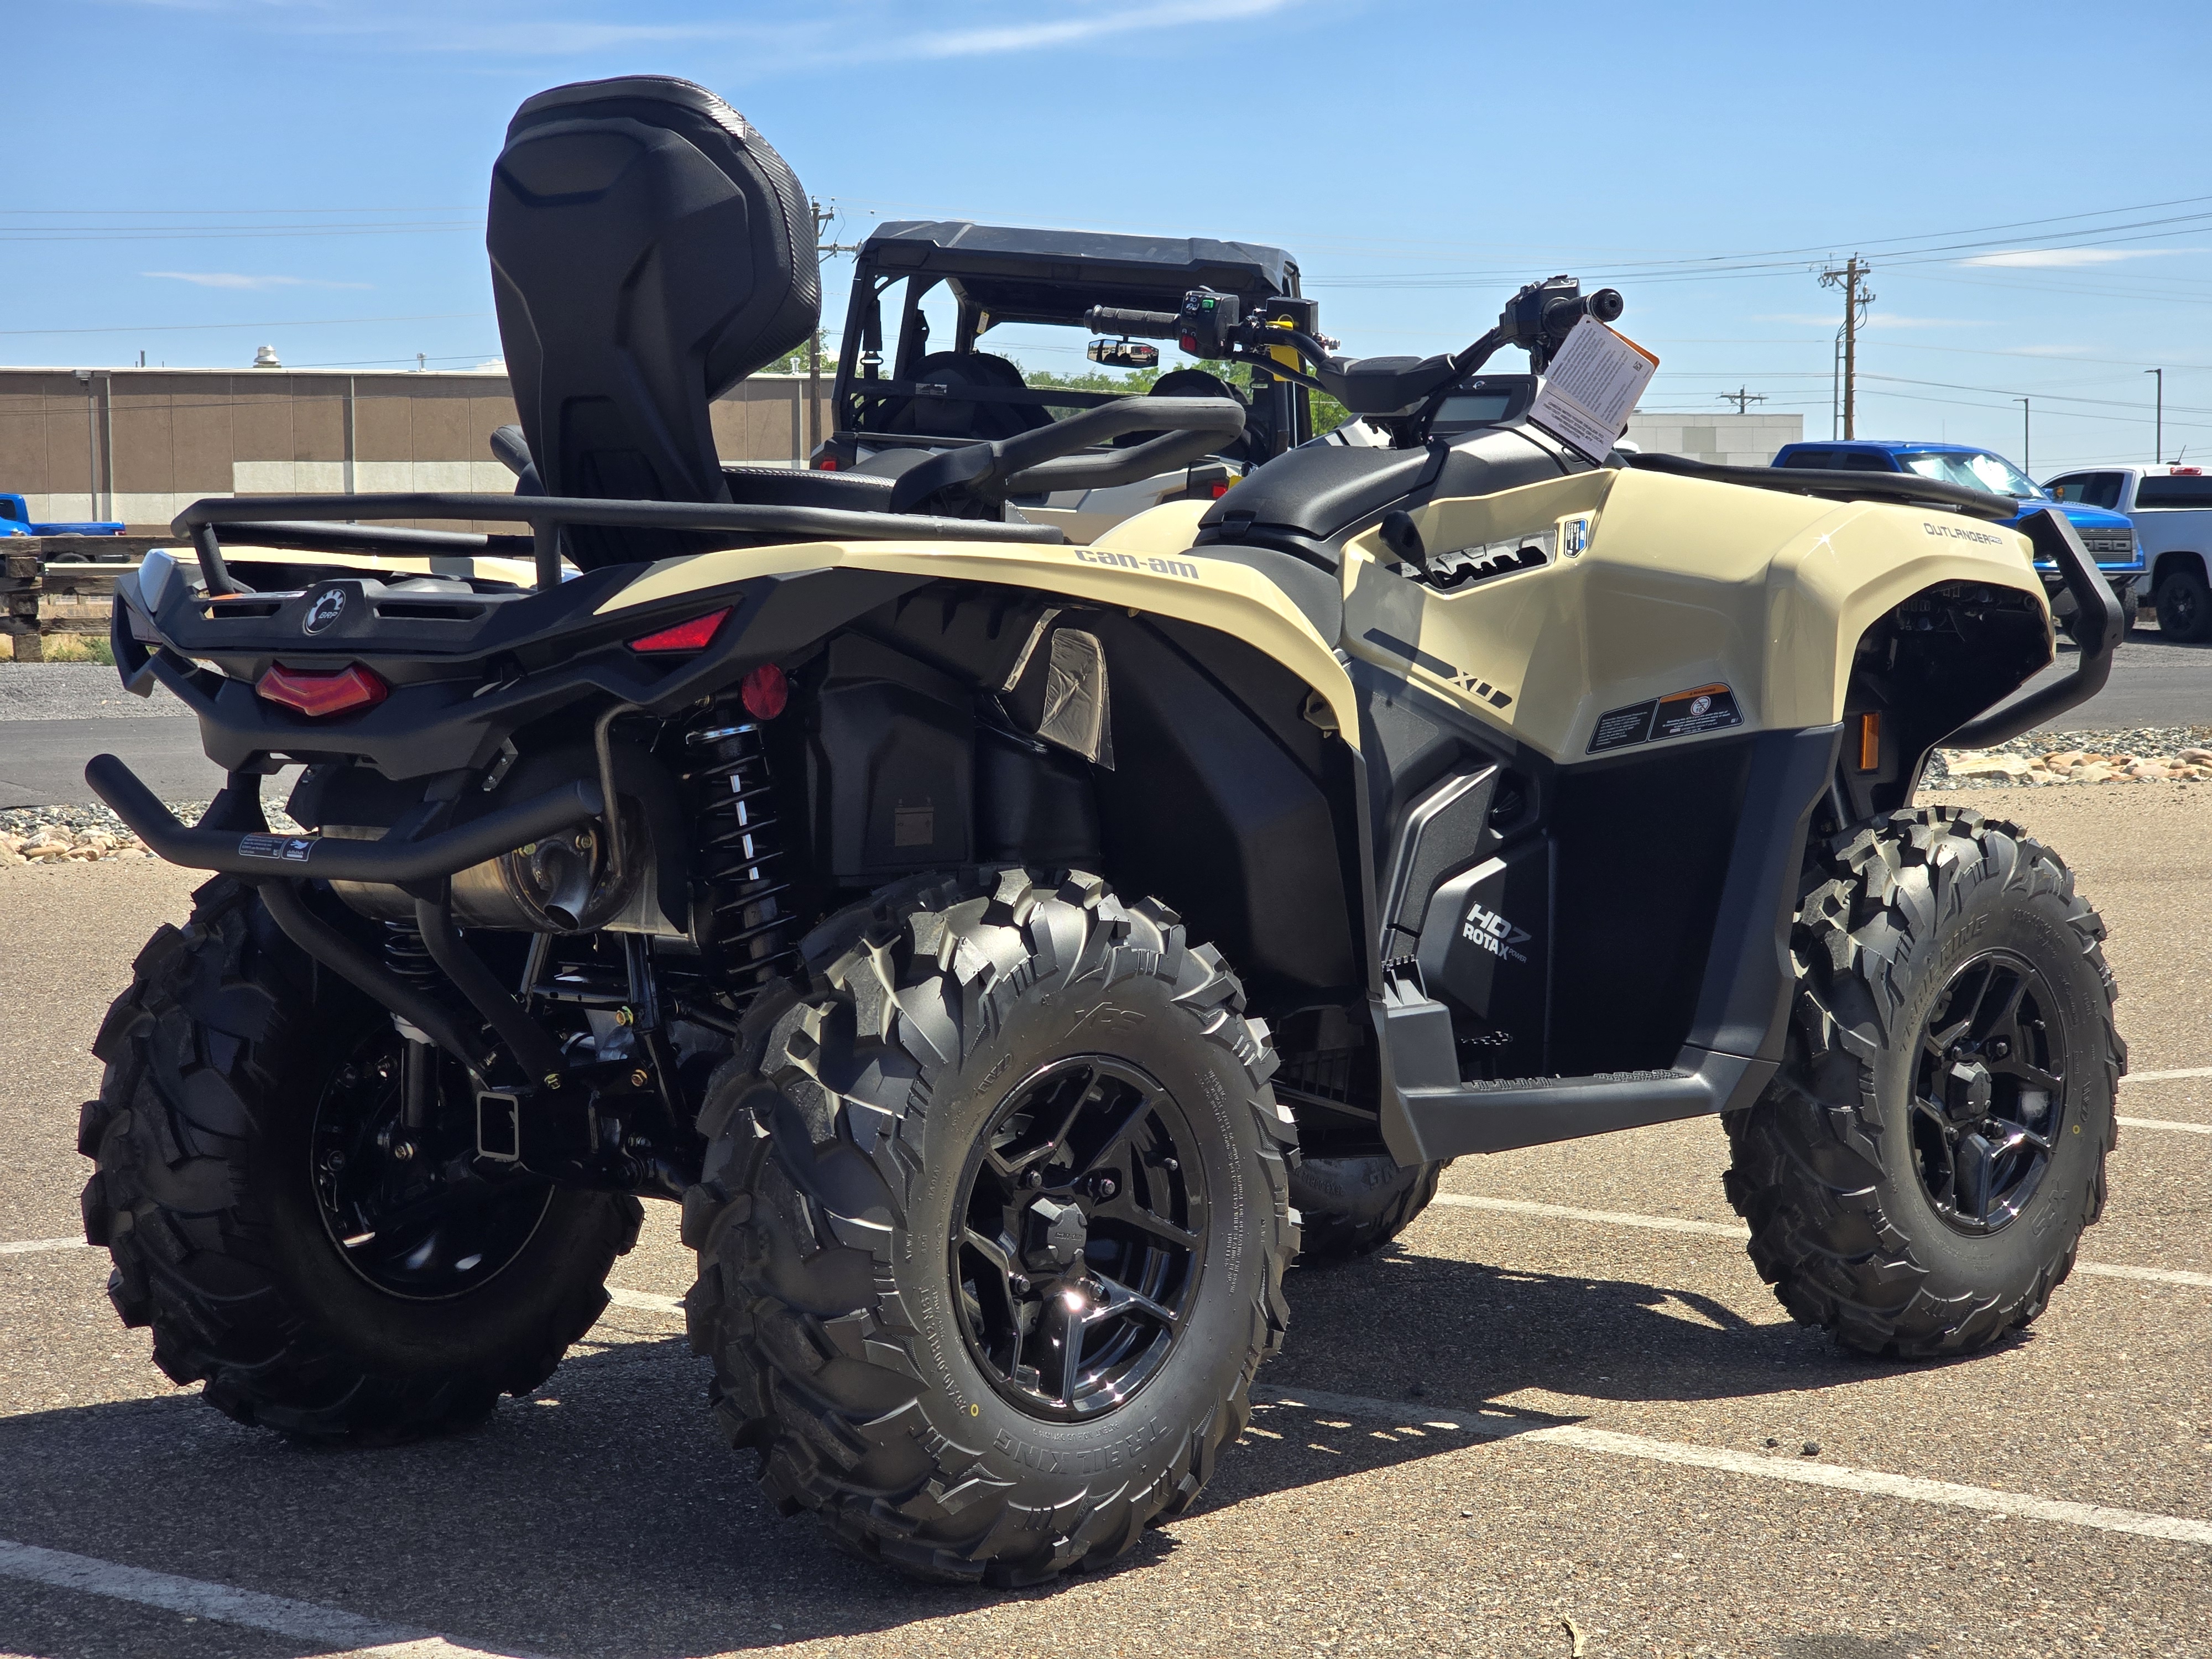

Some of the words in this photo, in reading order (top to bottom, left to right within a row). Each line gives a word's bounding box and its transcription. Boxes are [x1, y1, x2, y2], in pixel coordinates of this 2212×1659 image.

[1923, 523, 1991, 545] OUTLANDER
[1074, 550, 1199, 579] can-am
[1467, 904, 1532, 943] HD7
[1463, 922, 1507, 961] ROTAX
[1509, 948, 1527, 963] POWER
[1068, 1433, 1076, 1441] US
[1096, 1421, 1120, 1434] PATENT
[993, 1428, 1070, 1474] KING
[1077, 1416, 1168, 1474] TRAIL
